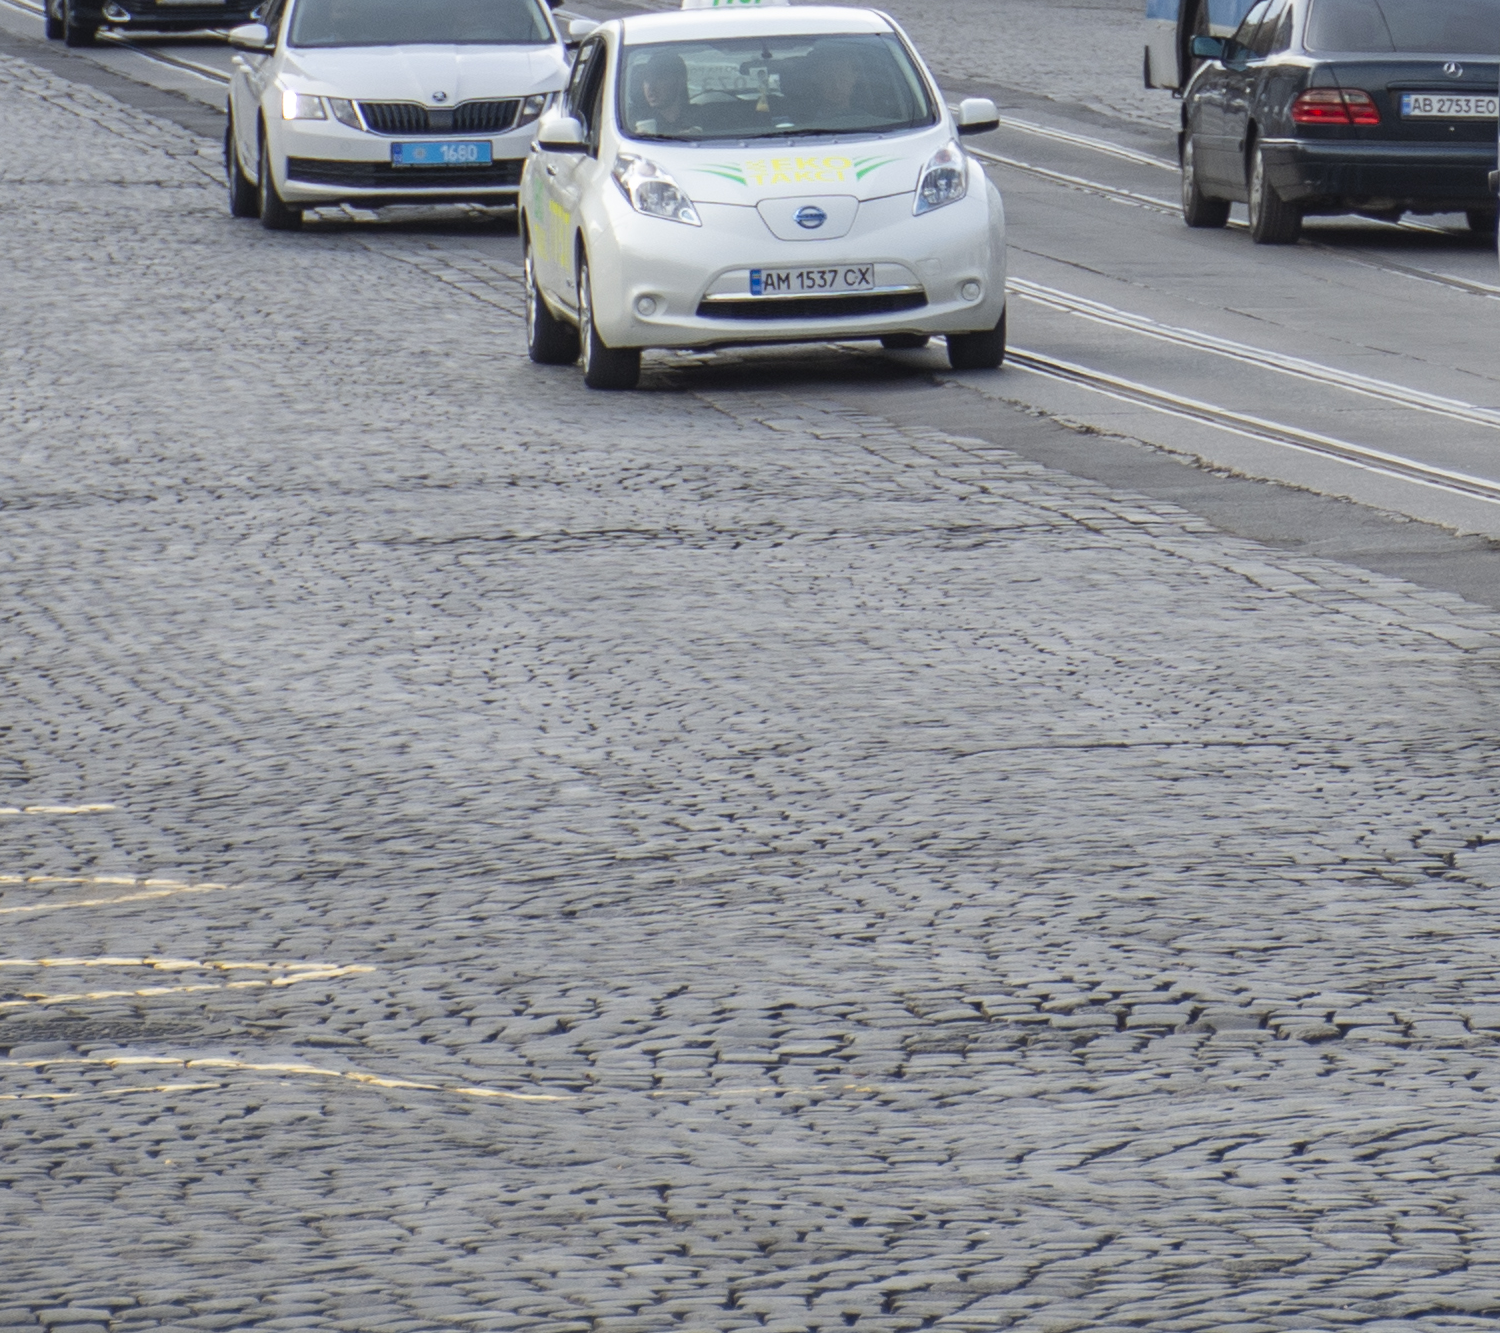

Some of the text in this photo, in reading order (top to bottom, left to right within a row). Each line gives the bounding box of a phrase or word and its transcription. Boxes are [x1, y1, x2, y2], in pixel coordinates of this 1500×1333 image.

[1412, 98, 1497, 113] AB 2753 EO
[441, 145, 478, 161] 1680
[764, 267, 871, 291] AM 1537 CX
